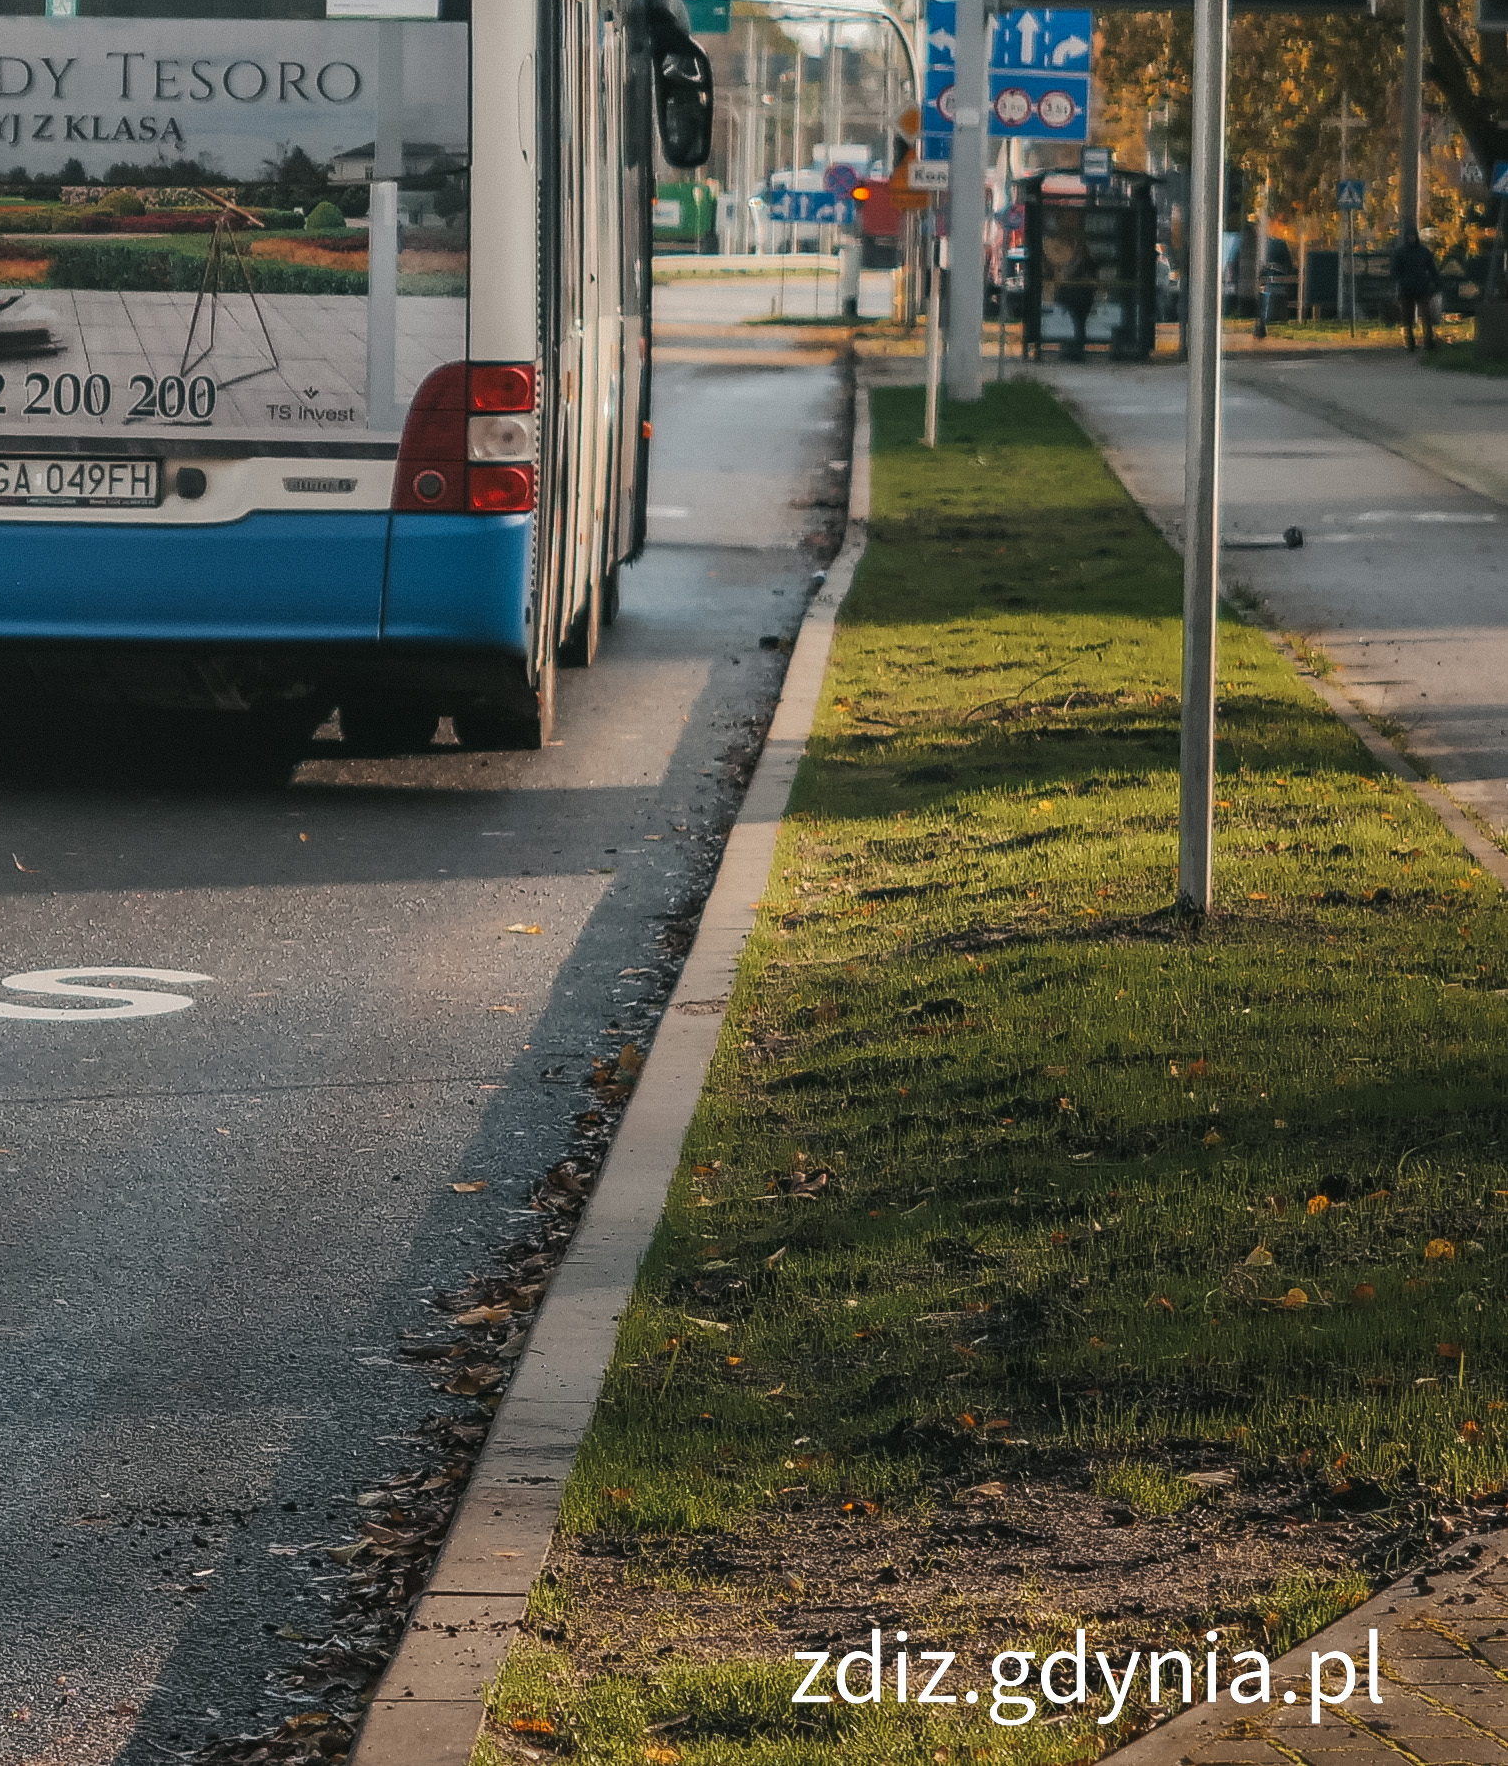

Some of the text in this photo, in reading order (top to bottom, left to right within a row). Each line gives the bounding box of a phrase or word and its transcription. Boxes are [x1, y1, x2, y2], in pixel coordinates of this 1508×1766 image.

[105, 51, 363, 104] TESORO
[32, 114, 54, 141] Z
[63, 114, 185, 151] KLASĄ
[21, 371, 112, 418] 200
[127, 373, 217, 420] 200
[266, 403, 292, 421] TS
[46, 462, 150, 497] 049FH
